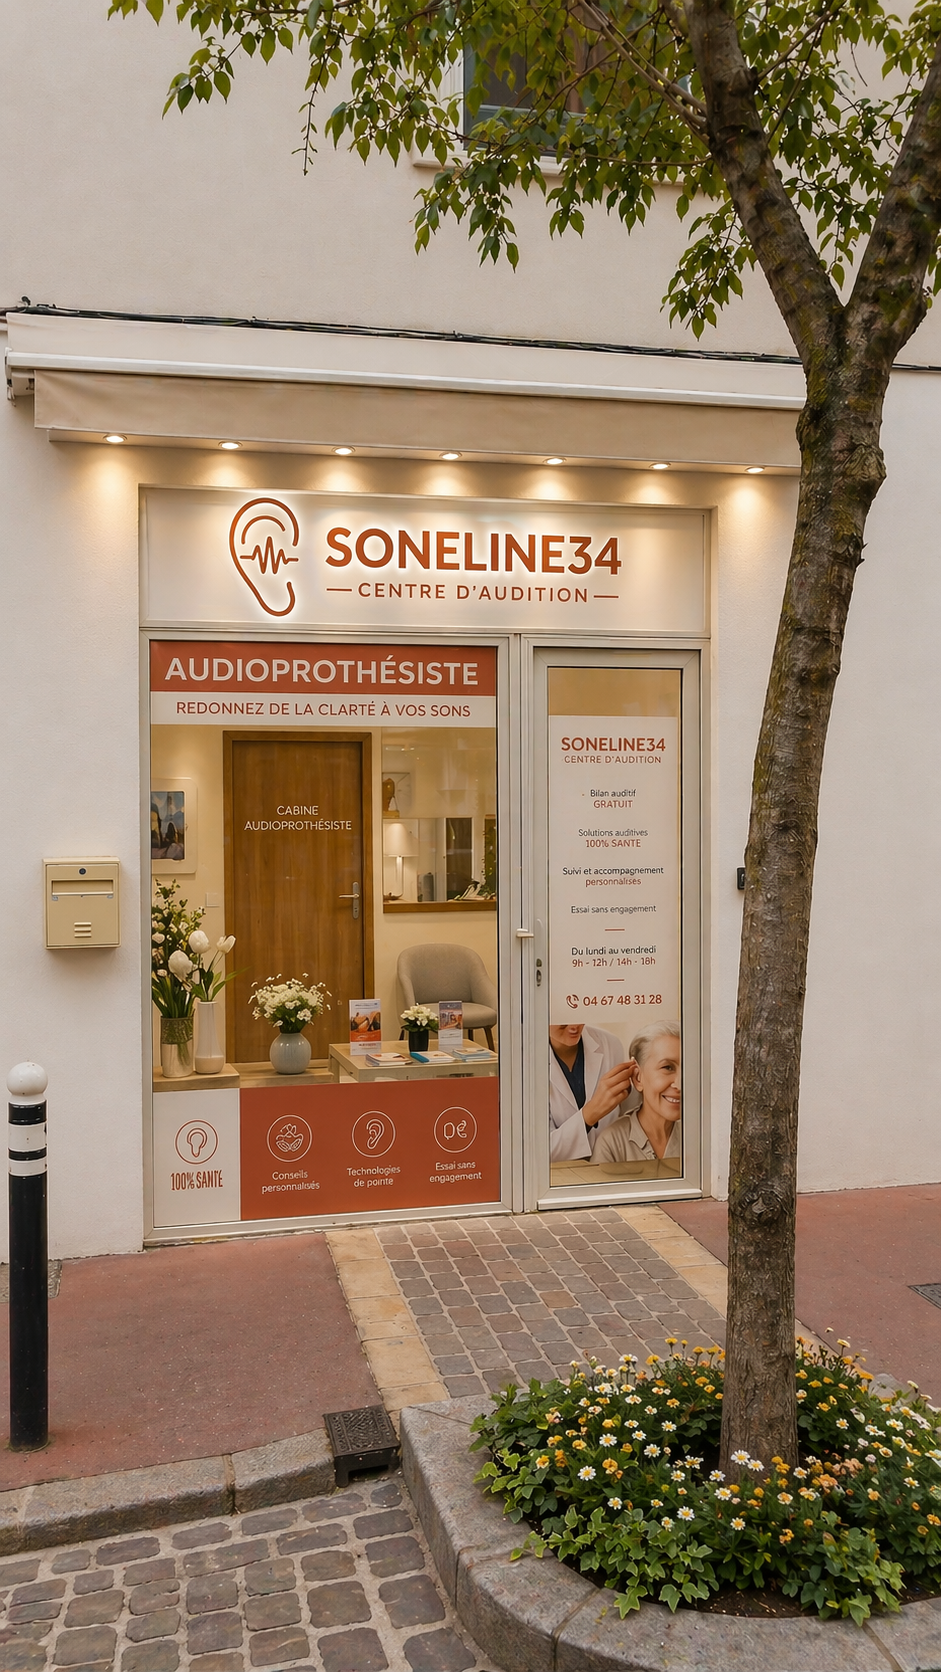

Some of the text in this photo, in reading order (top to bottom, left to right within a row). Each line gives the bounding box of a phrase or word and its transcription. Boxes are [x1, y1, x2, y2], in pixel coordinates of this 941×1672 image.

[325, 526, 622, 575] SONELINE34
[358, 582, 588, 602] CENTRE D'AUDITION
[164, 654, 478, 686] AUDIOPROTHÉSISTE
[176, 700, 470, 718] REDONNEZ DE LA CLARTÉ À VOS SONS
[561, 737, 666, 752] SONELINE34
[564, 755, 662, 764] CENTRE D'AUDITION
[590, 788, 636, 798] Bilan auditif
[593, 800, 633, 808] GRATUIT
[276, 805, 319, 816] CABINE
[244, 818, 352, 831] AUDIOPROTHÉSISTE
[578, 828, 649, 837] Solutions auditives
[586, 839, 610, 848] 100%
[562, 866, 582, 876] Suivi
[593, 867, 664, 876] accompagnement
[570, 905, 657, 915] Essai sans engagement
[571, 946, 584, 956] Du
[586, 946, 606, 956] lundi
[620, 945, 657, 955] vendredi
[572, 958, 584, 968] 9h
[592, 958, 608, 967] 12h
[609, 958, 614, 967] /
[616, 957, 632, 966] 14h
[640, 956, 656, 966] 18h
[582, 994, 662, 1006] 04 67 48 31 28
[346, 1165, 401, 1176] Technologies
[435, 1161, 476, 1171] Essai sans
[272, 1169, 308, 1180] Conseils
[429, 1172, 482, 1184] engagement
[170, 1172, 195, 1190] 100%
[354, 1178, 394, 1188] de pointe
